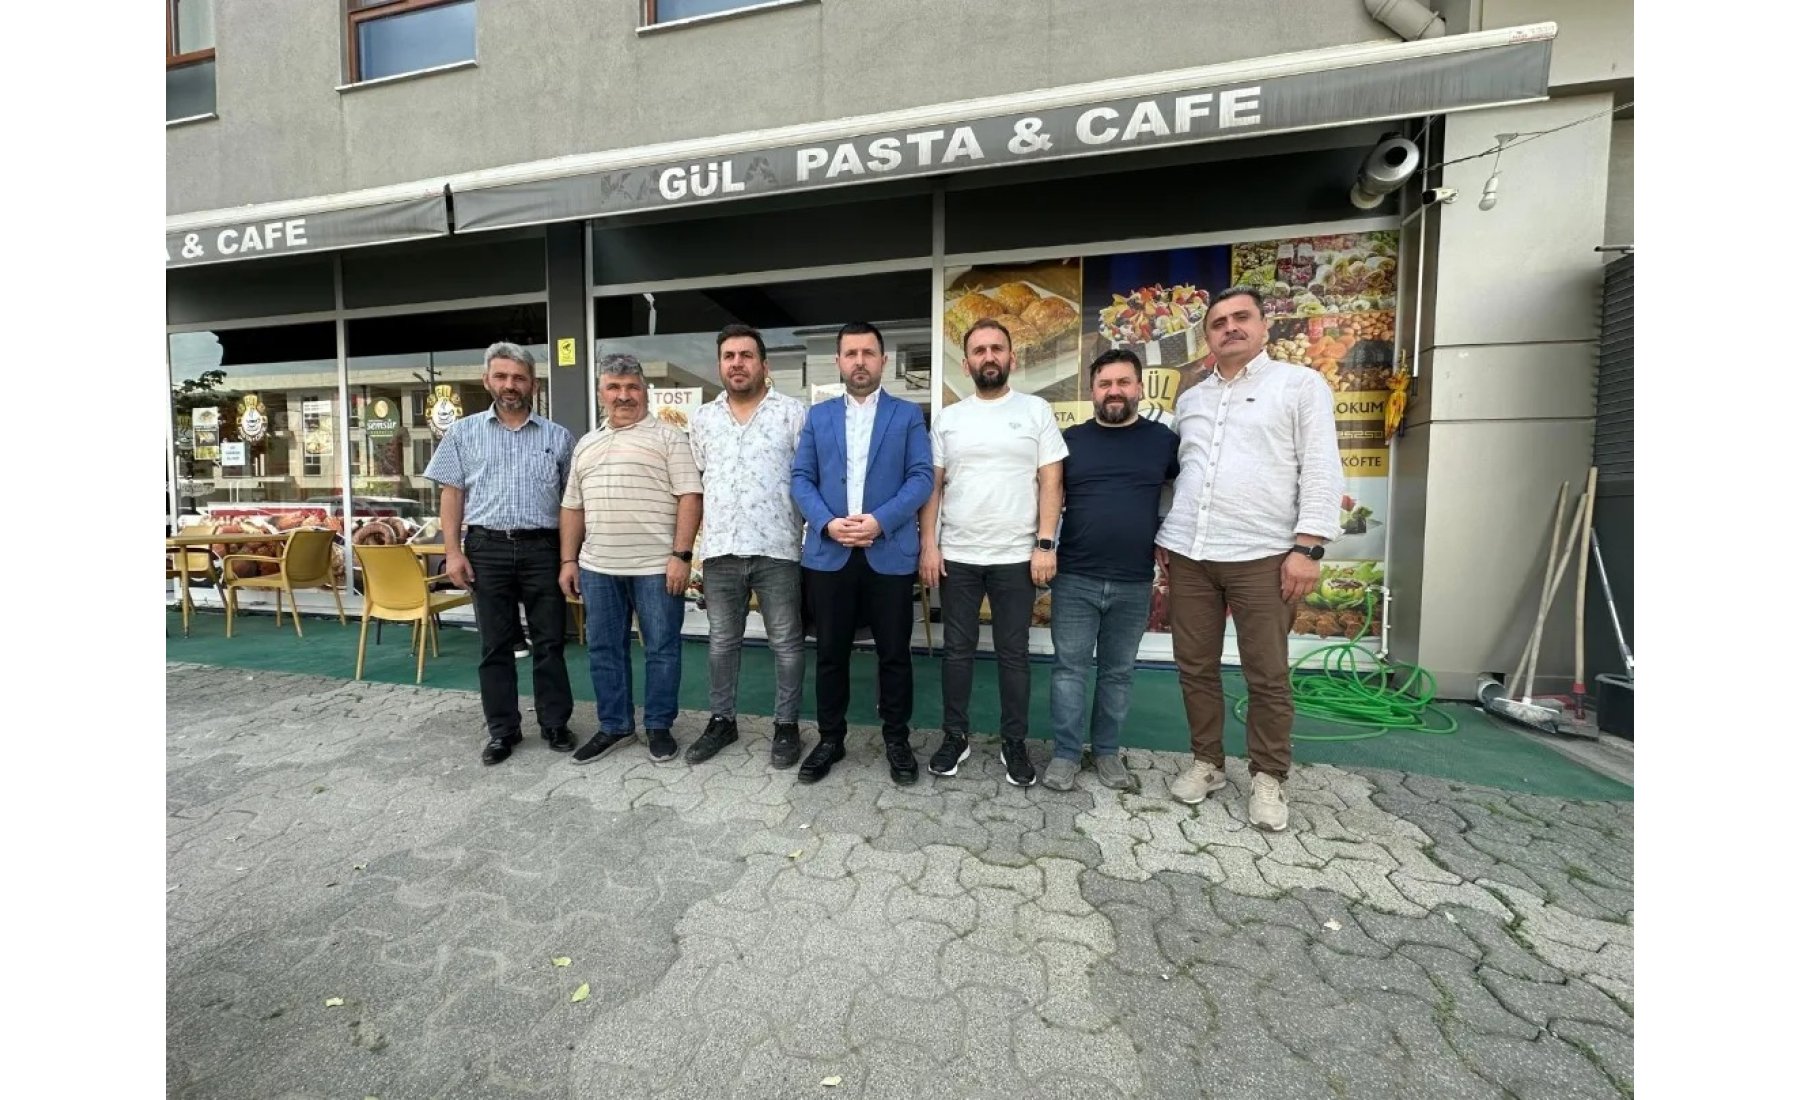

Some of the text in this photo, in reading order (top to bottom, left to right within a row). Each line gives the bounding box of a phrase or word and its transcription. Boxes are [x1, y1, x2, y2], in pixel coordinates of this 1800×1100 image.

[658, 160, 745, 200] GÜL
[796, 125, 985, 182] PASTA
[1007, 116, 1053, 153] &
[1075, 86, 1262, 145] CAFE
[181, 233, 205, 259] &
[217, 219, 308, 254] CAFE
[1140, 370, 1171, 401] ÜL
[653, 391, 692, 405] TOST
[1333, 400, 1384, 414] OKUM
[1054, 411, 1075, 422] STA
[1341, 455, 1382, 468] KÖFTE
